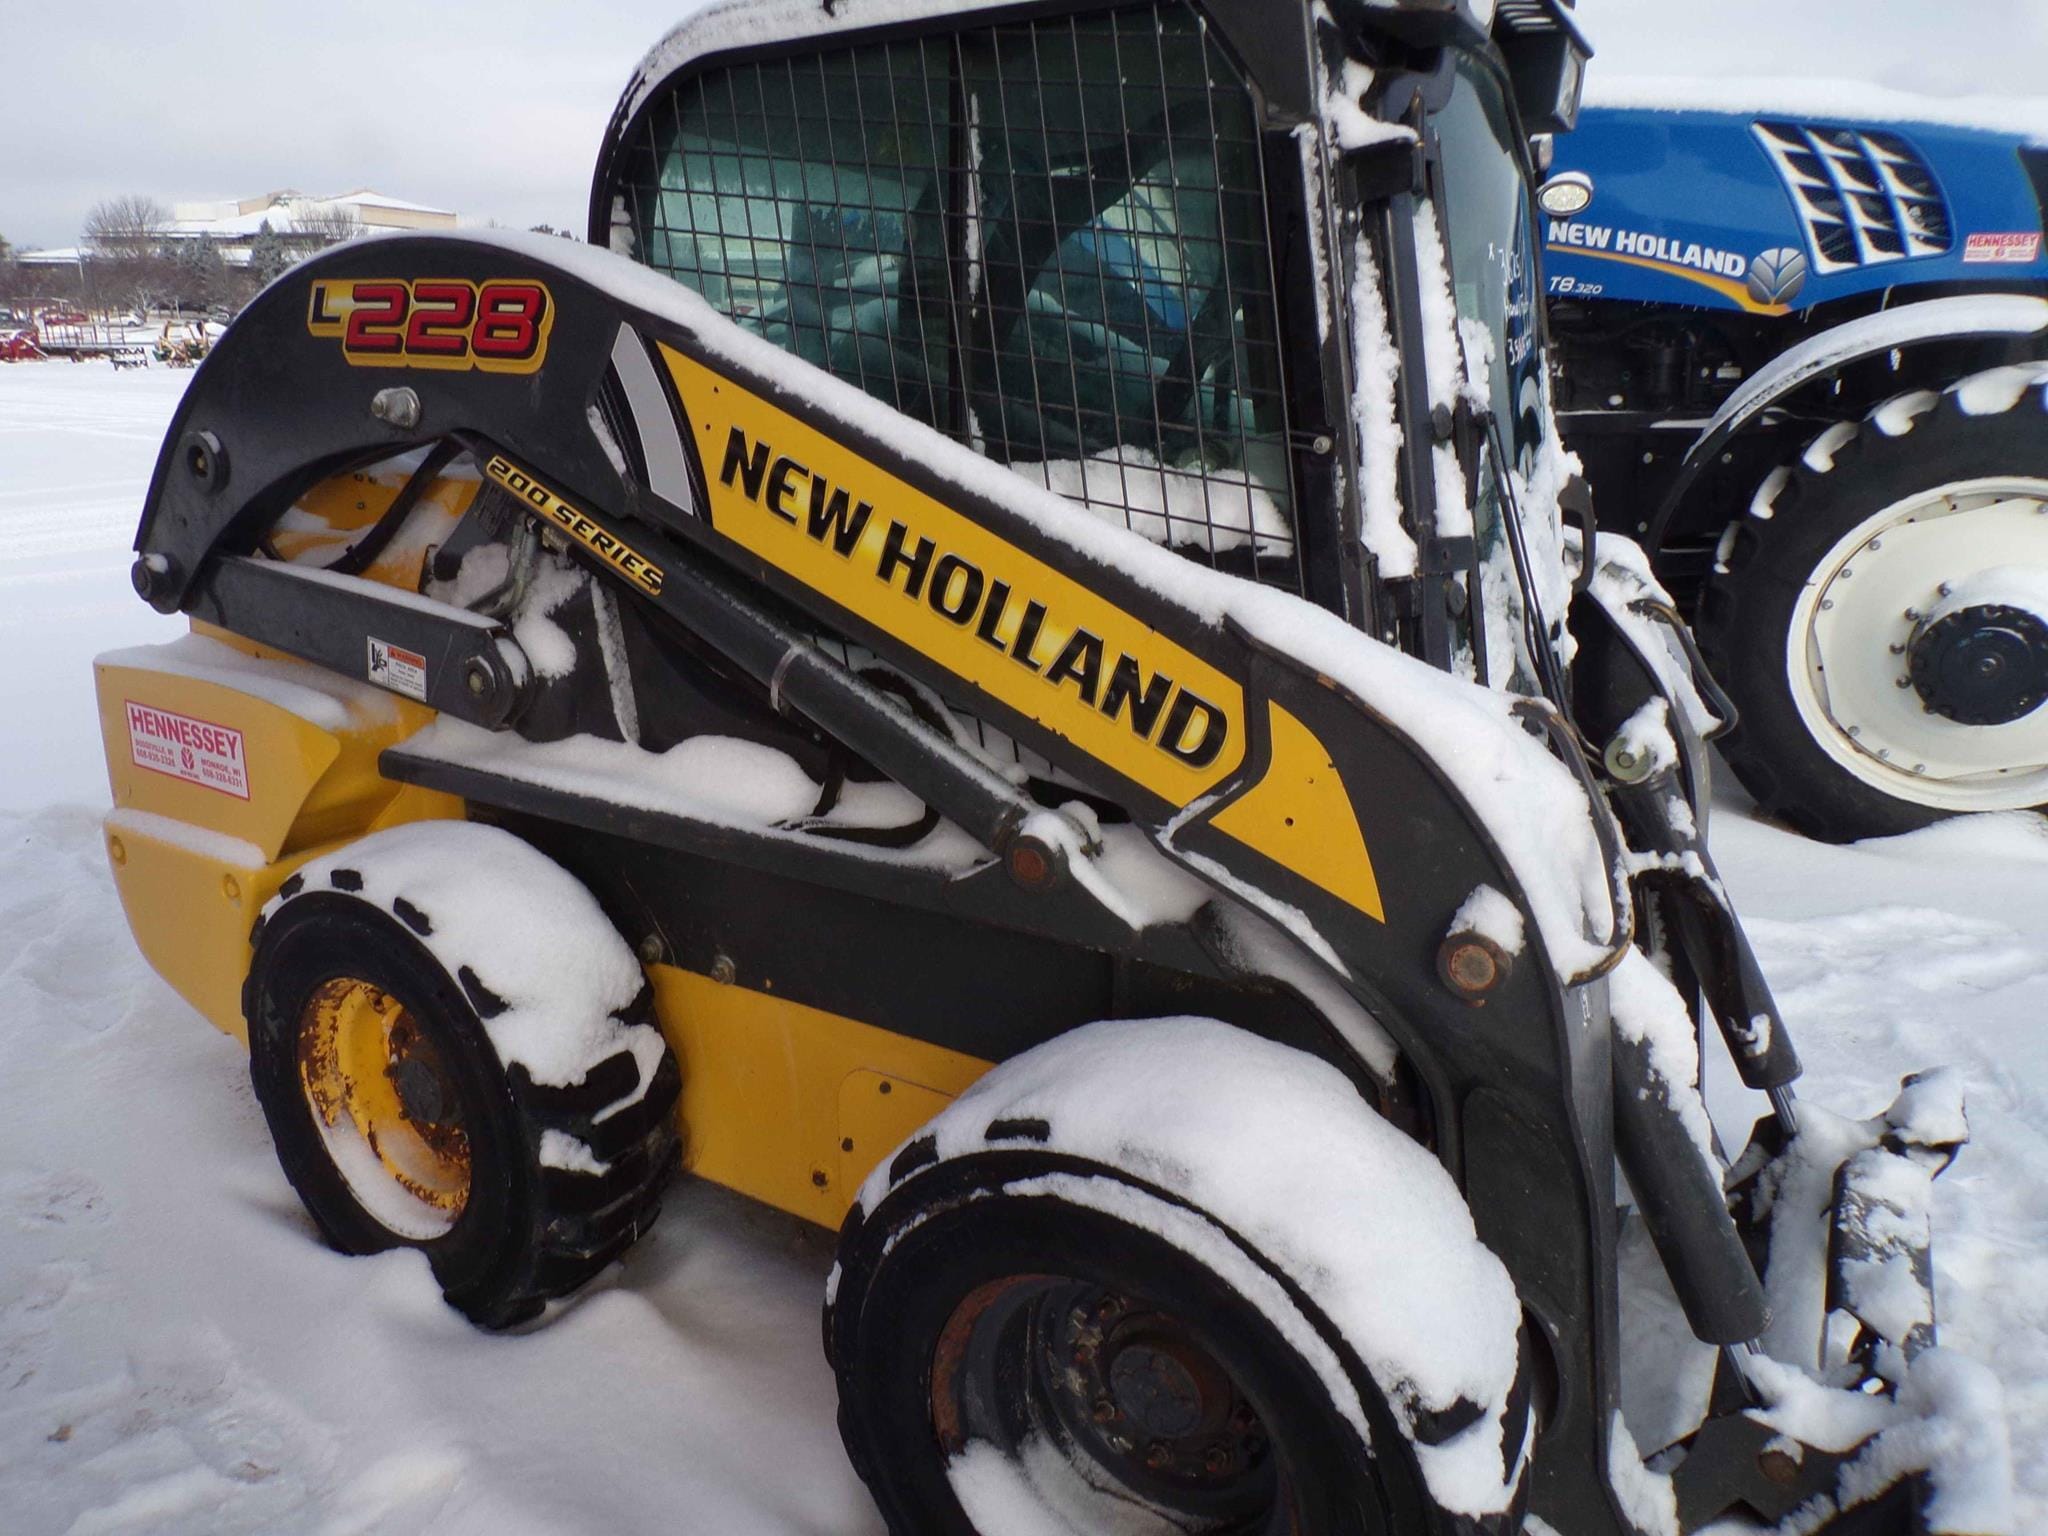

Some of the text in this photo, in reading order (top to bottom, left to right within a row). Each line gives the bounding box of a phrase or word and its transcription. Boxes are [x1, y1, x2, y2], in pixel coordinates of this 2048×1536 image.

[1548, 221, 1746, 277] NEW HOLLAND
[1968, 233, 2037, 246] HENNESSEY
[1550, 276, 1602, 294] T8.320
[488, 458, 663, 591] 200 SERIES
[719, 425, 1229, 769] NEW HOLLAND
[130, 707, 238, 760] HENNESSEY
